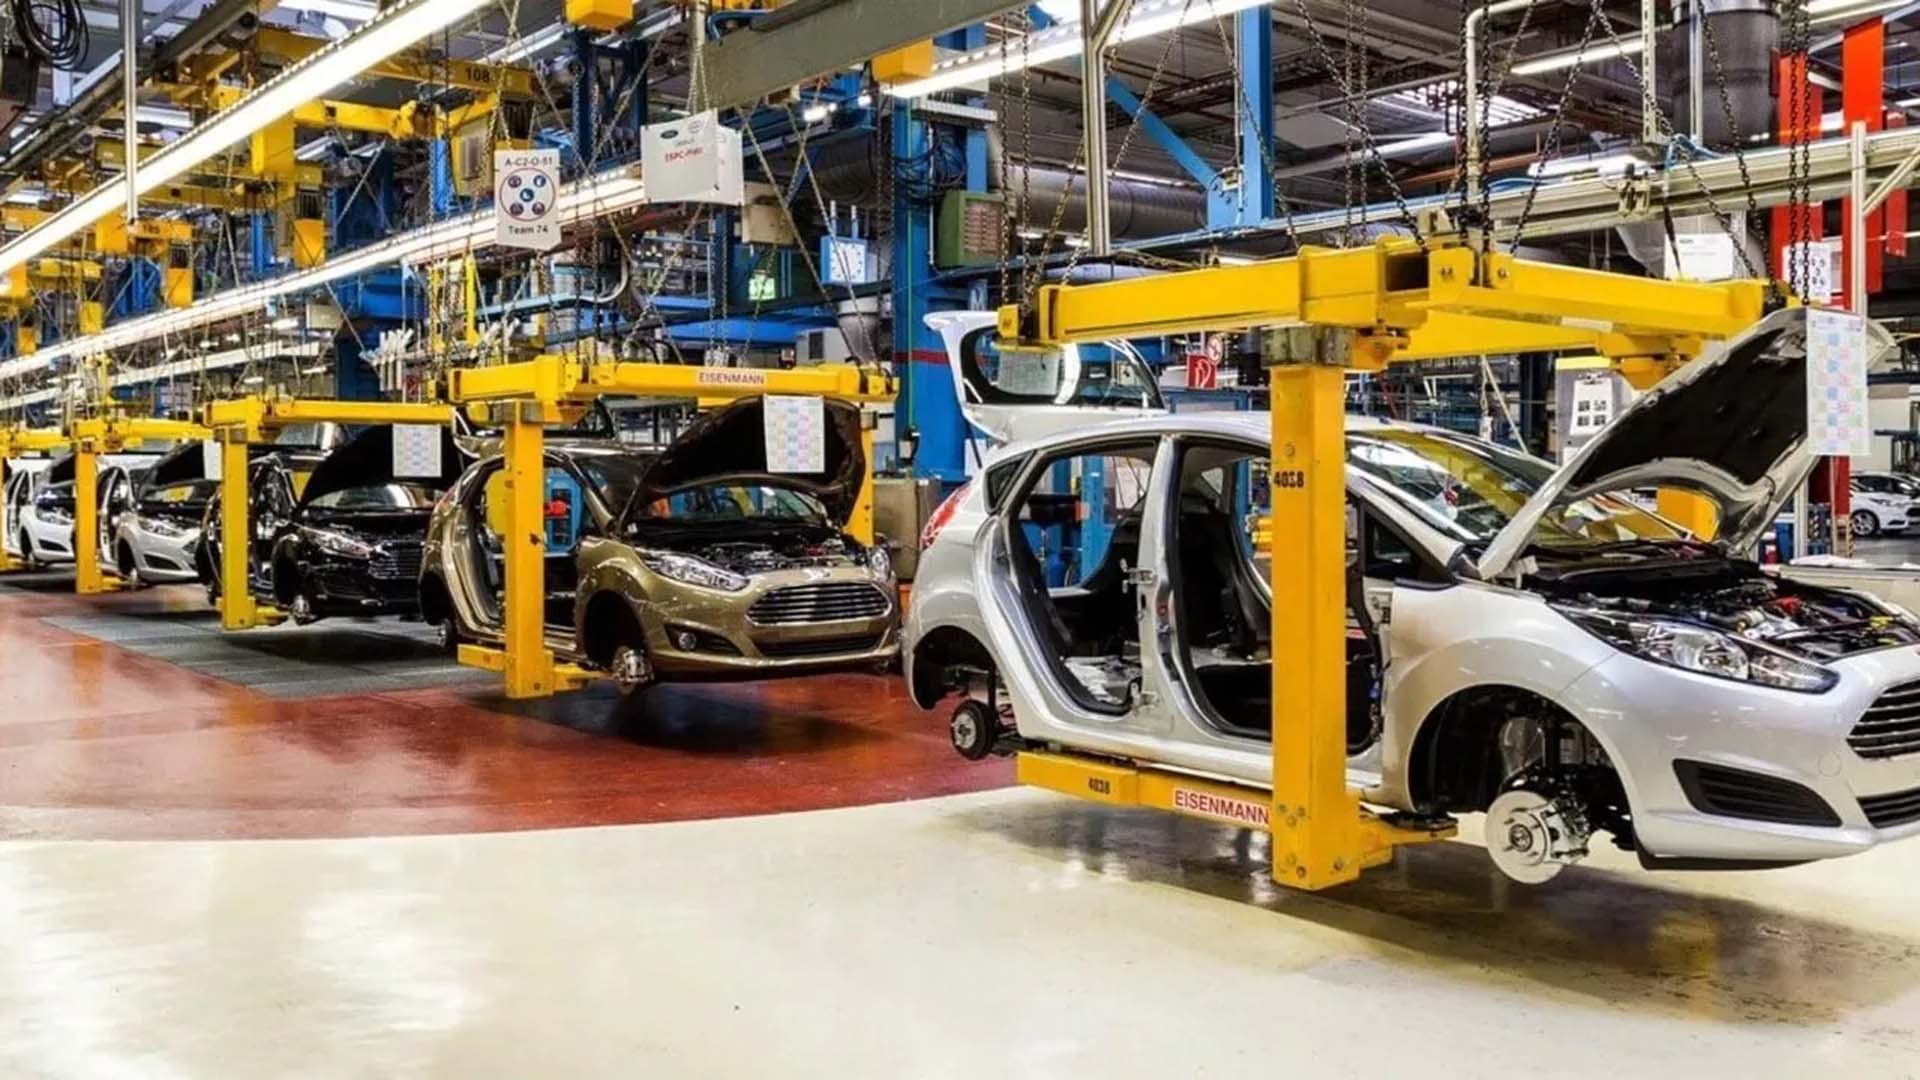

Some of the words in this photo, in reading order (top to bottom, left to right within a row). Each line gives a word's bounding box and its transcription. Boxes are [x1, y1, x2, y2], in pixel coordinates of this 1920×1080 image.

[465, 65, 489, 82] 108
[508, 225, 534, 234] Team
[537, 225, 548, 233] 74
[699, 372, 764, 384] EISENMANN
[1175, 790, 1269, 824] EISENMANN
